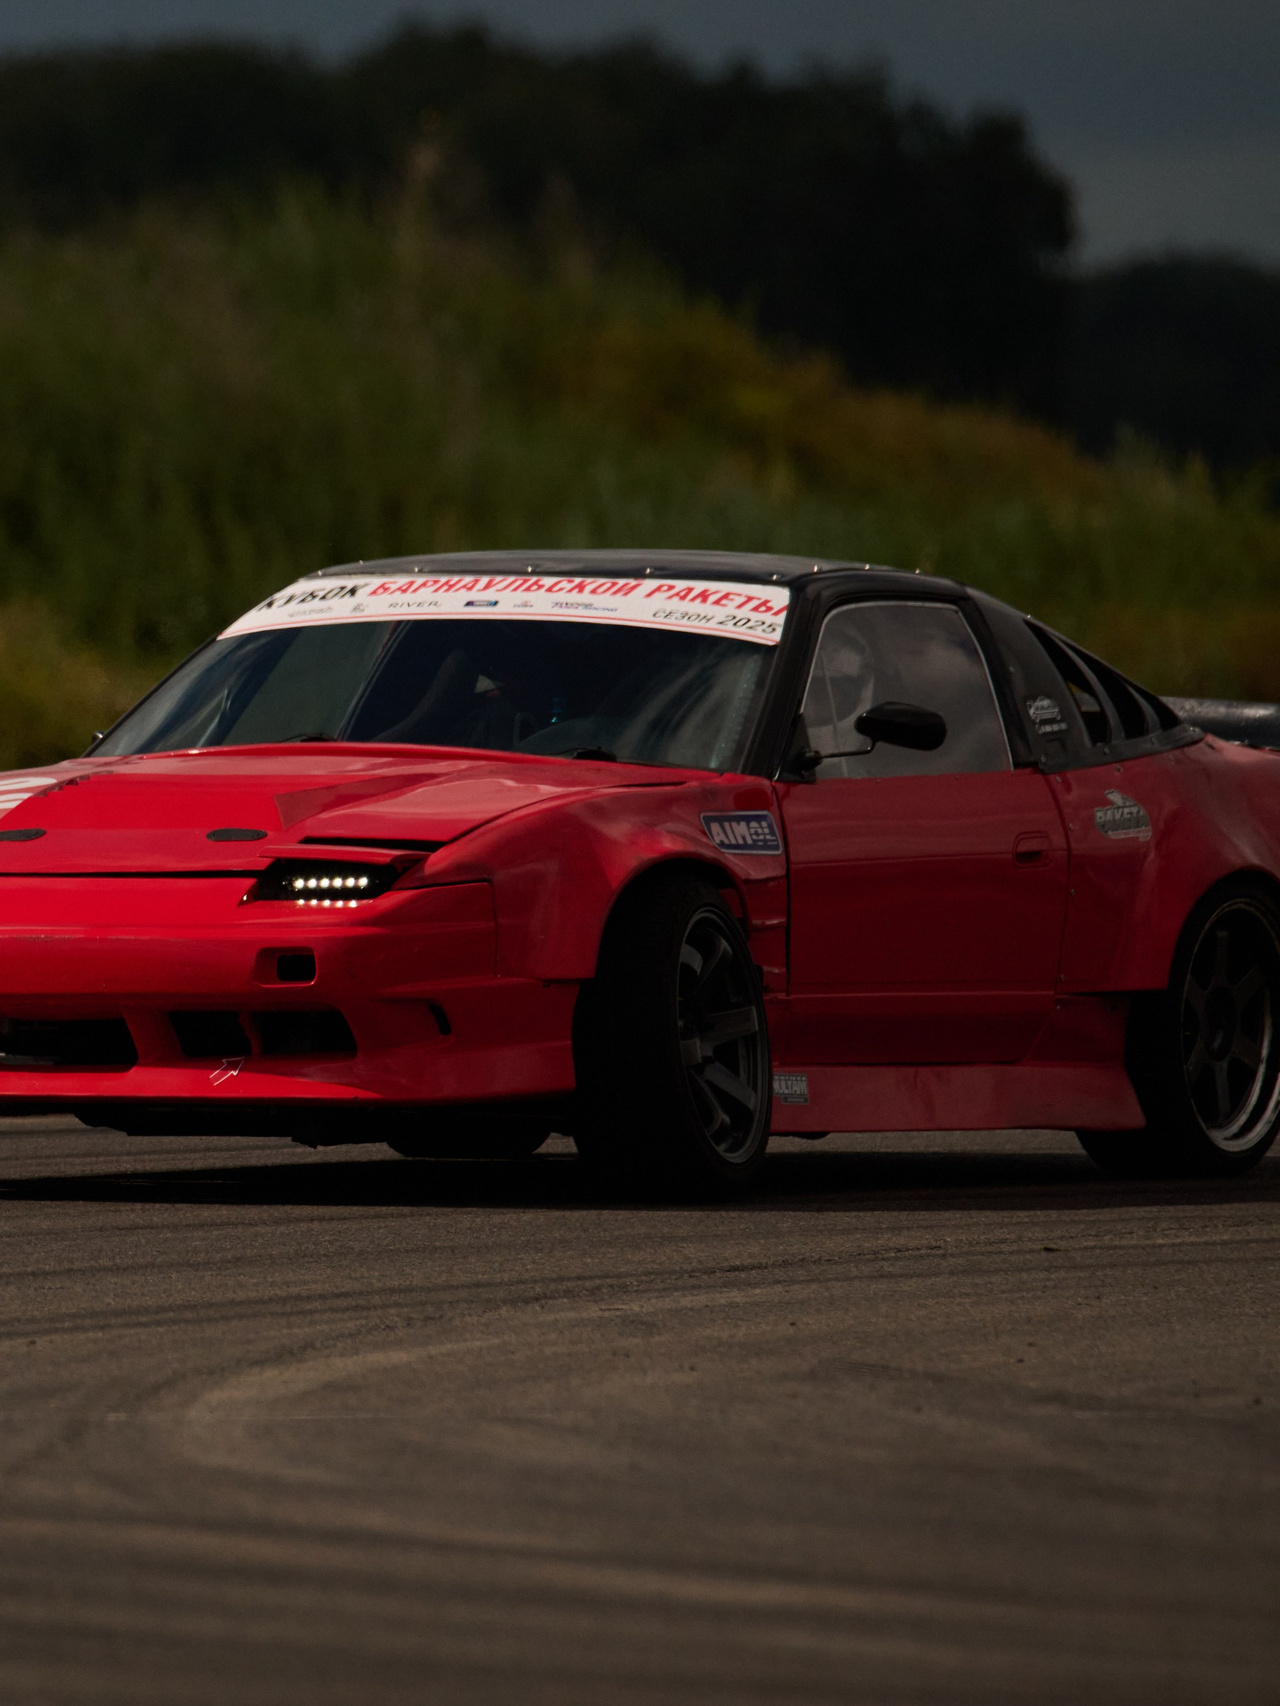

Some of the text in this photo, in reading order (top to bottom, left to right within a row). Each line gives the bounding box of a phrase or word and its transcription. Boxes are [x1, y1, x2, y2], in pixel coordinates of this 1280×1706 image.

[257, 583, 371, 612] КУБОК
[368, 577, 647, 598] БАРНАУЛЬСКОЙ
[644, 584, 790, 617] РАКЕТЫ
[652, 609, 783, 635] СЕЗОН 2025
[710, 820, 778, 846] AIMOL
